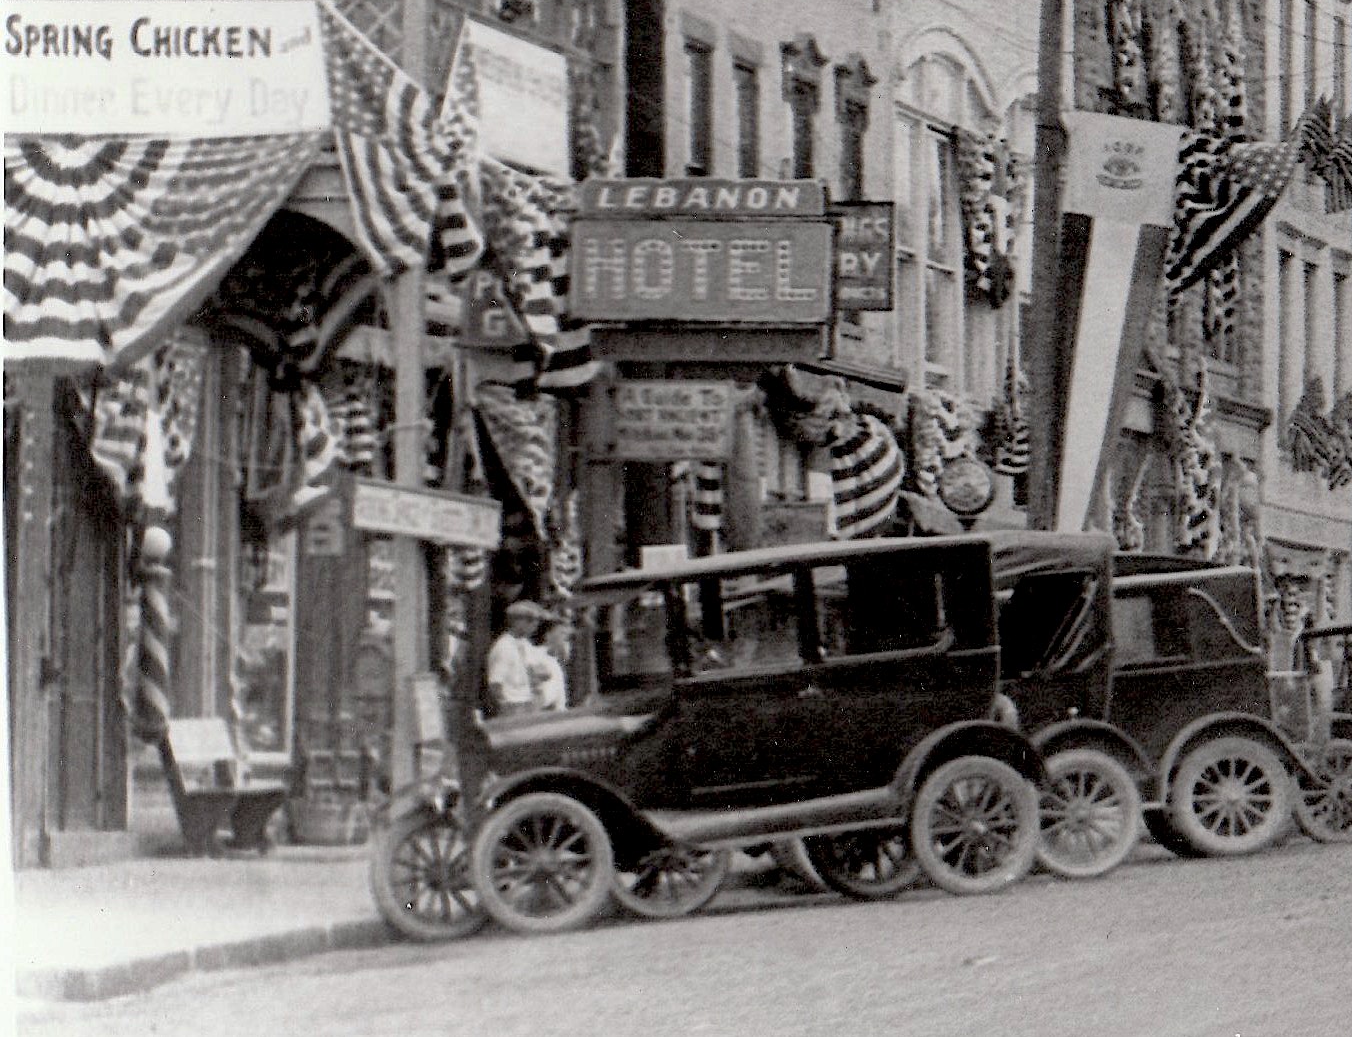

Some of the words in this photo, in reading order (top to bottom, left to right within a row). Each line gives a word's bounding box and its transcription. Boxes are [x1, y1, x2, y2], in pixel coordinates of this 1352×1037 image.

[5, 13, 114, 61] SPRING
[129, 15, 272, 59] CHICKEN
[130, 75, 232, 125] Every
[249, 76, 310, 125] Day
[598, 186, 800, 210] LEBANON
[581, 238, 817, 302] HOTEL
